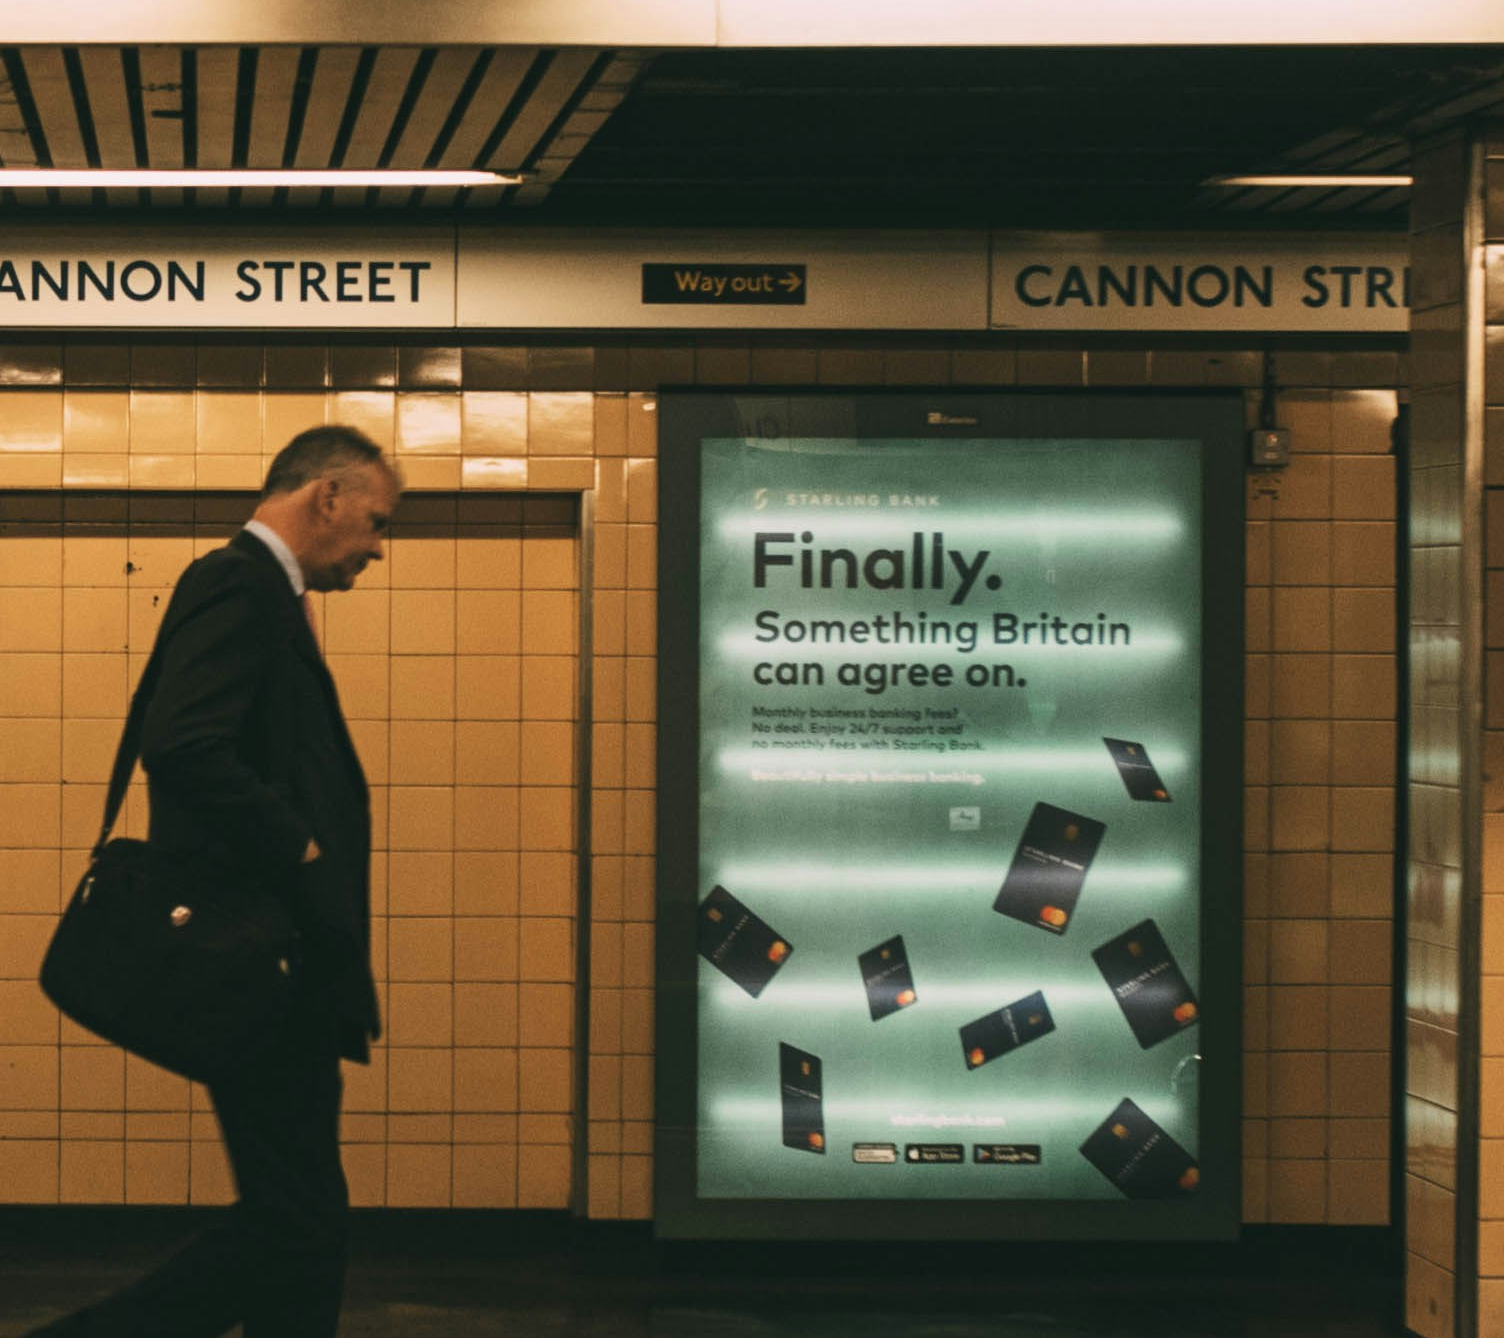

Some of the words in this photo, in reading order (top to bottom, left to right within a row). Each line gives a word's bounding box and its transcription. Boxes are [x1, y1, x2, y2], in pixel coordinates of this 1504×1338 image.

[235, 261, 431, 303] STREET
[674, 271, 728, 297] Way
[730, 273, 775, 293] out
[1013, 265, 1273, 309] CANNON
[1301, 265, 1411, 308] STR
[786, 493, 880, 507] STARLING
[888, 494, 941, 507] BANK
[753, 530, 1003, 606] Finally.
[754, 610, 979, 653] Something
[992, 612, 1131, 645] Britain
[753, 662, 825, 686] can
[837, 662, 954, 694] agree
[965, 663, 1027, 688] on.
[752, 705, 805, 720] Monthly
[810, 706, 865, 718] business
[869, 707, 921, 721] banking
[925, 707, 959, 719] fees?
[752, 722, 772, 734] No
[774, 722, 804, 734] deal.
[810, 723, 845, 736] Enjoy
[849, 723, 879, 734] 24/7
[882, 724, 934, 736] support
[938, 724, 964, 735] and
[752, 741, 769, 749] no
[772, 738, 825, 751] monthly
[829, 739, 856, 750] fees
[860, 739, 889, 750] with
[894, 739, 945, 752] Starling
[949, 740, 985, 751] Bank.
